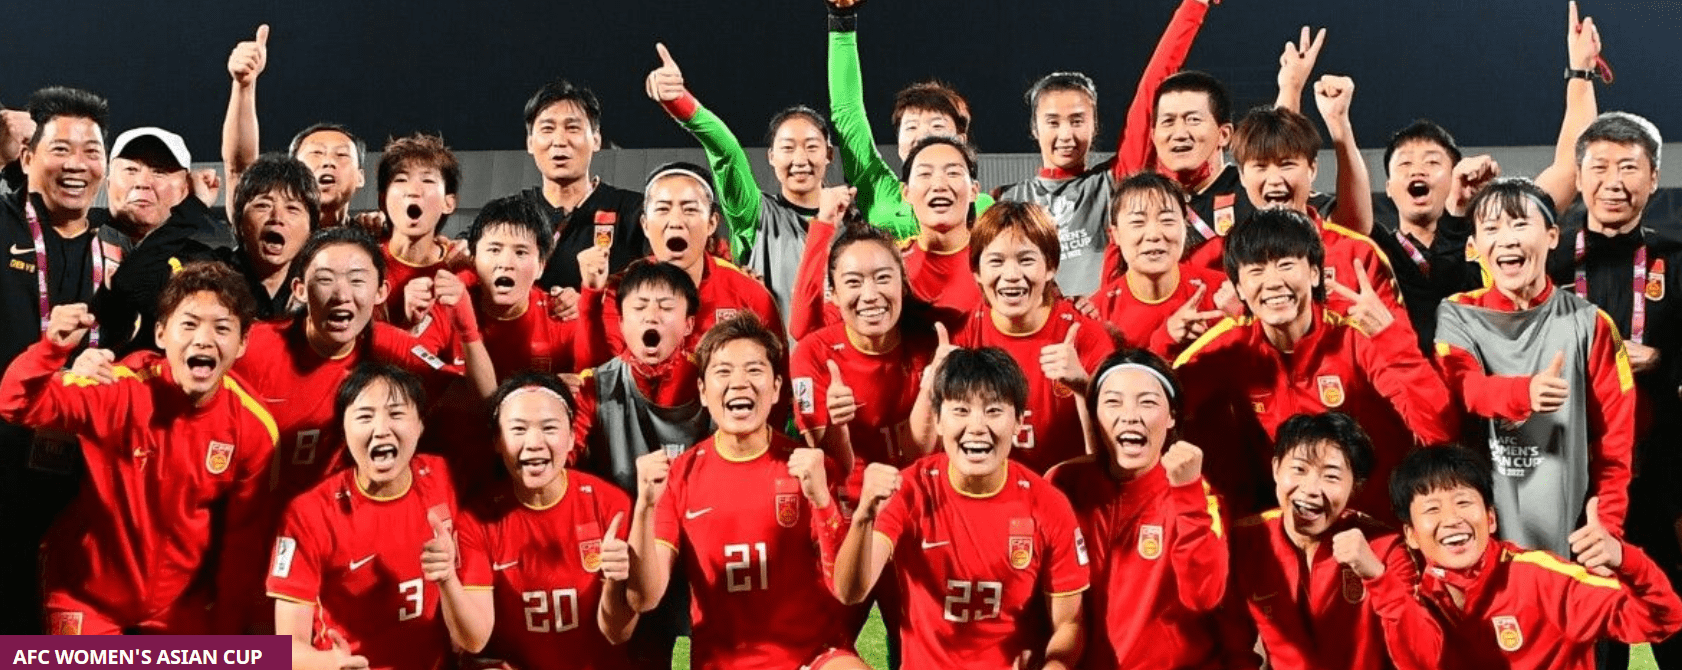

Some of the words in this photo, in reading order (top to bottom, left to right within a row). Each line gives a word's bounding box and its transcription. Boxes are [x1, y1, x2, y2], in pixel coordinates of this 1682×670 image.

[292, 429, 320, 465] 8
[1513, 456, 1543, 468] CUP
[724, 542, 768, 592] 21
[399, 578, 424, 621] 3
[522, 588, 579, 633] 20
[944, 578, 1003, 623] 23
